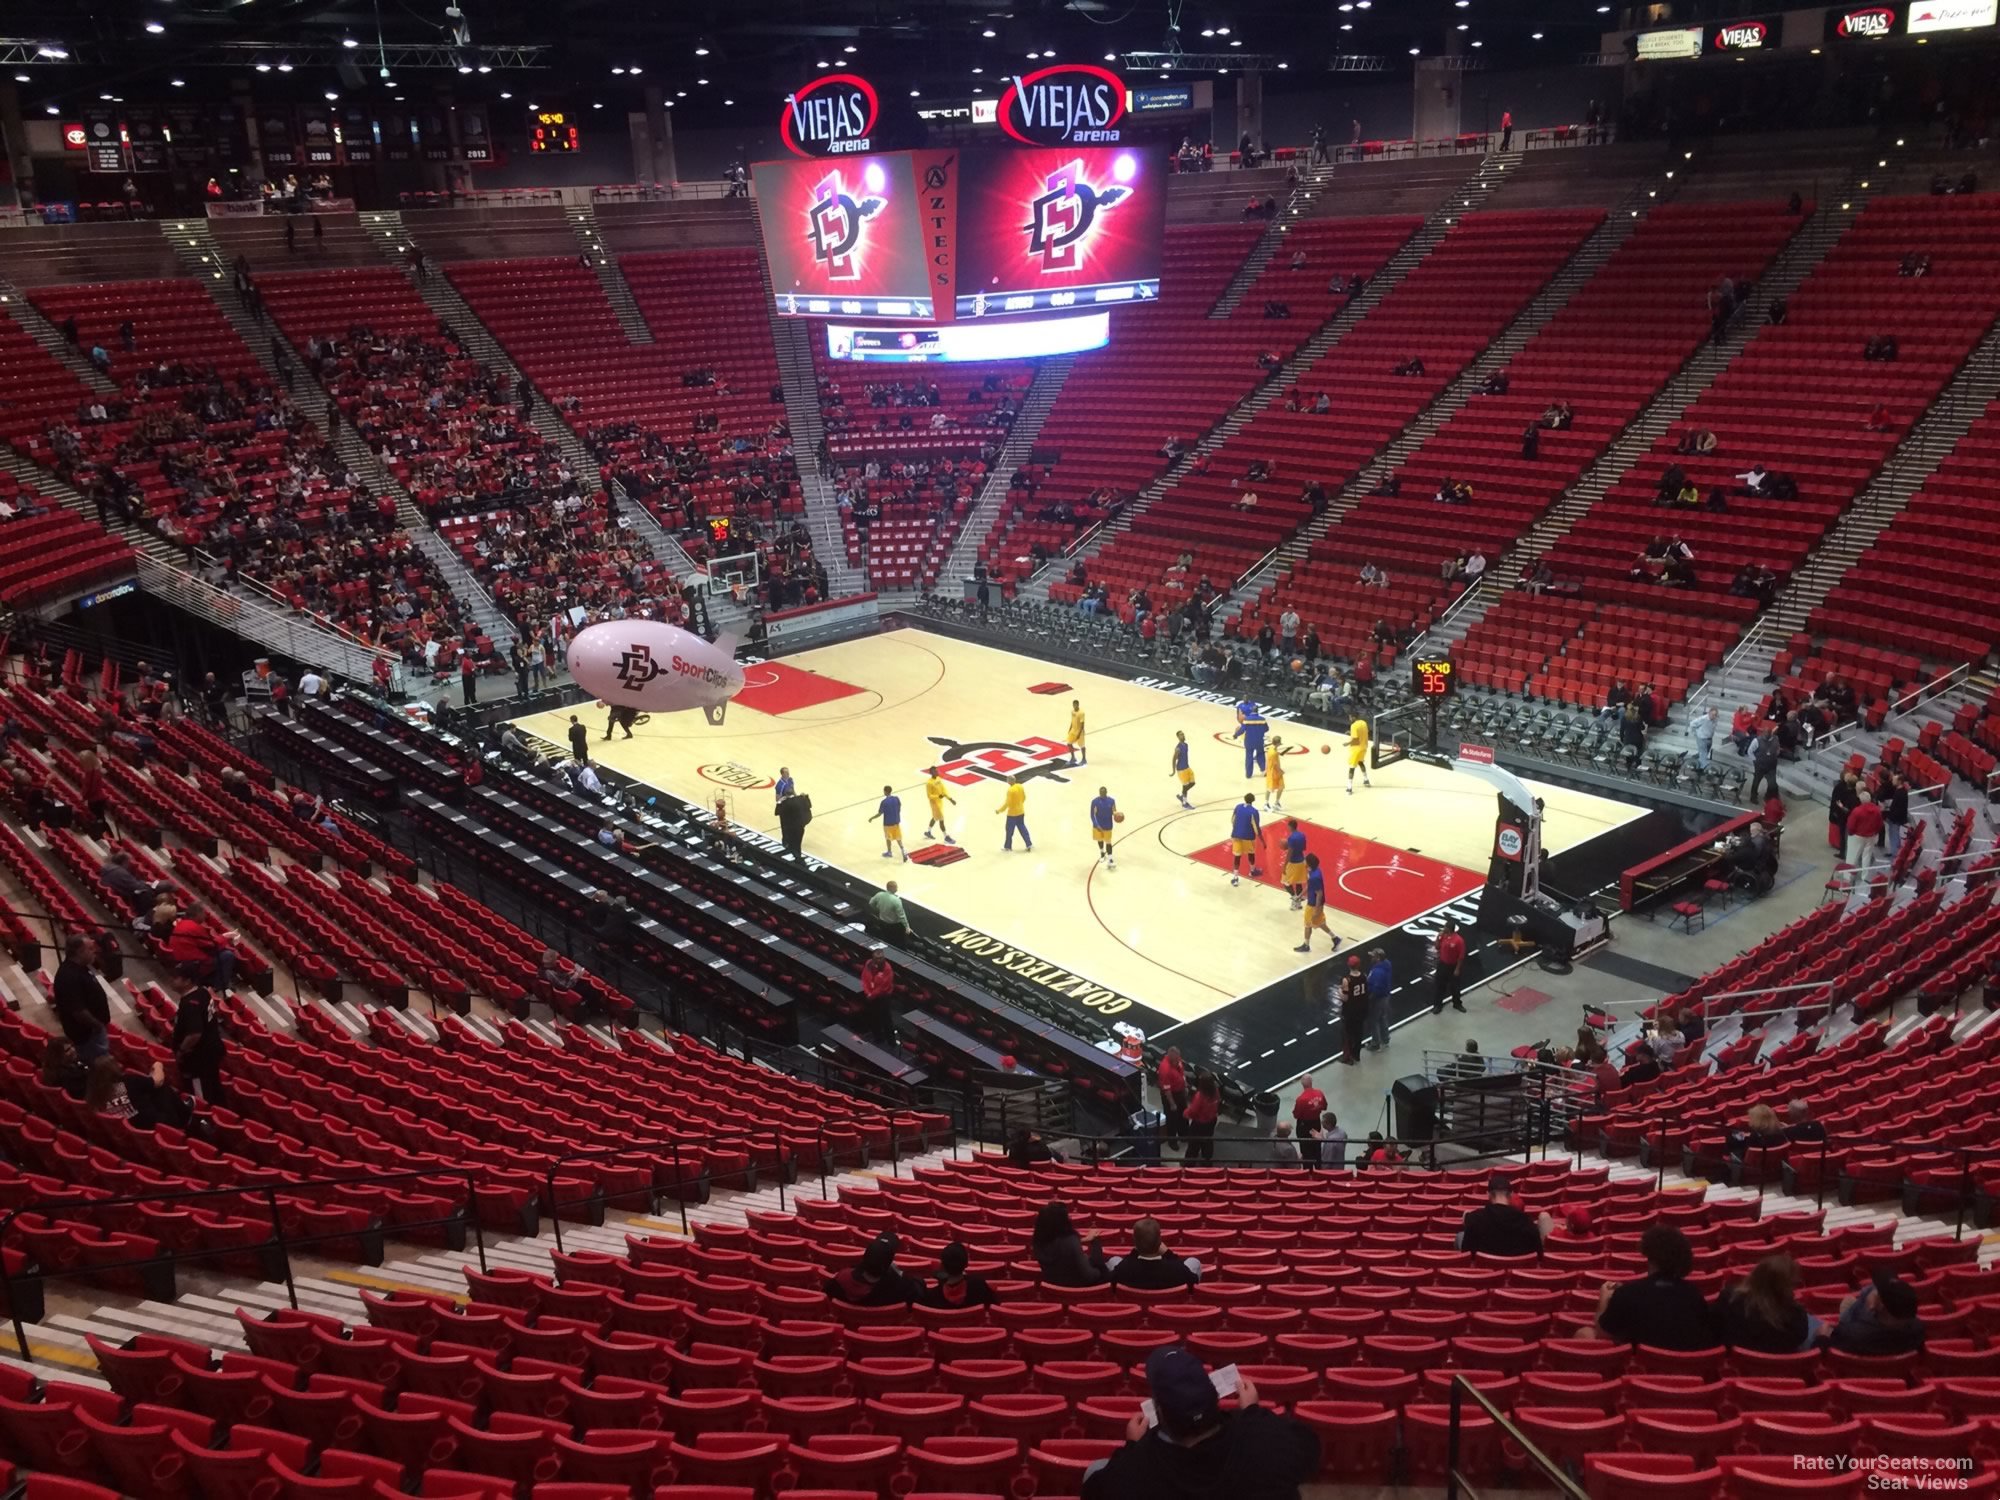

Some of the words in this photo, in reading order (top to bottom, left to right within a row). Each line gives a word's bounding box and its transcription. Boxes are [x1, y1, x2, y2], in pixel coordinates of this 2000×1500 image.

[1844, 14, 1886, 35] VIEJAS
[1721, 28, 1760, 48] VIEJAS
[1013, 75, 1110, 140] VIEJAS
[538, 113, 563, 125] 45:40
[788, 92, 865, 152] VIEJAS
[1073, 128, 1120, 142] arena
[831, 137, 870, 153] arena
[714, 527, 728, 541] 35
[1417, 663, 1451, 674] 45:40
[1129, 676, 1176, 691] SAN
[1167, 685, 1236, 709] DIEGO
[1423, 674, 1446, 692] 35
[706, 765, 764, 791] VIEJAS
[939, 927, 1132, 1014] GOAZTECS.COM
[1353, 984, 1366, 996] 21
